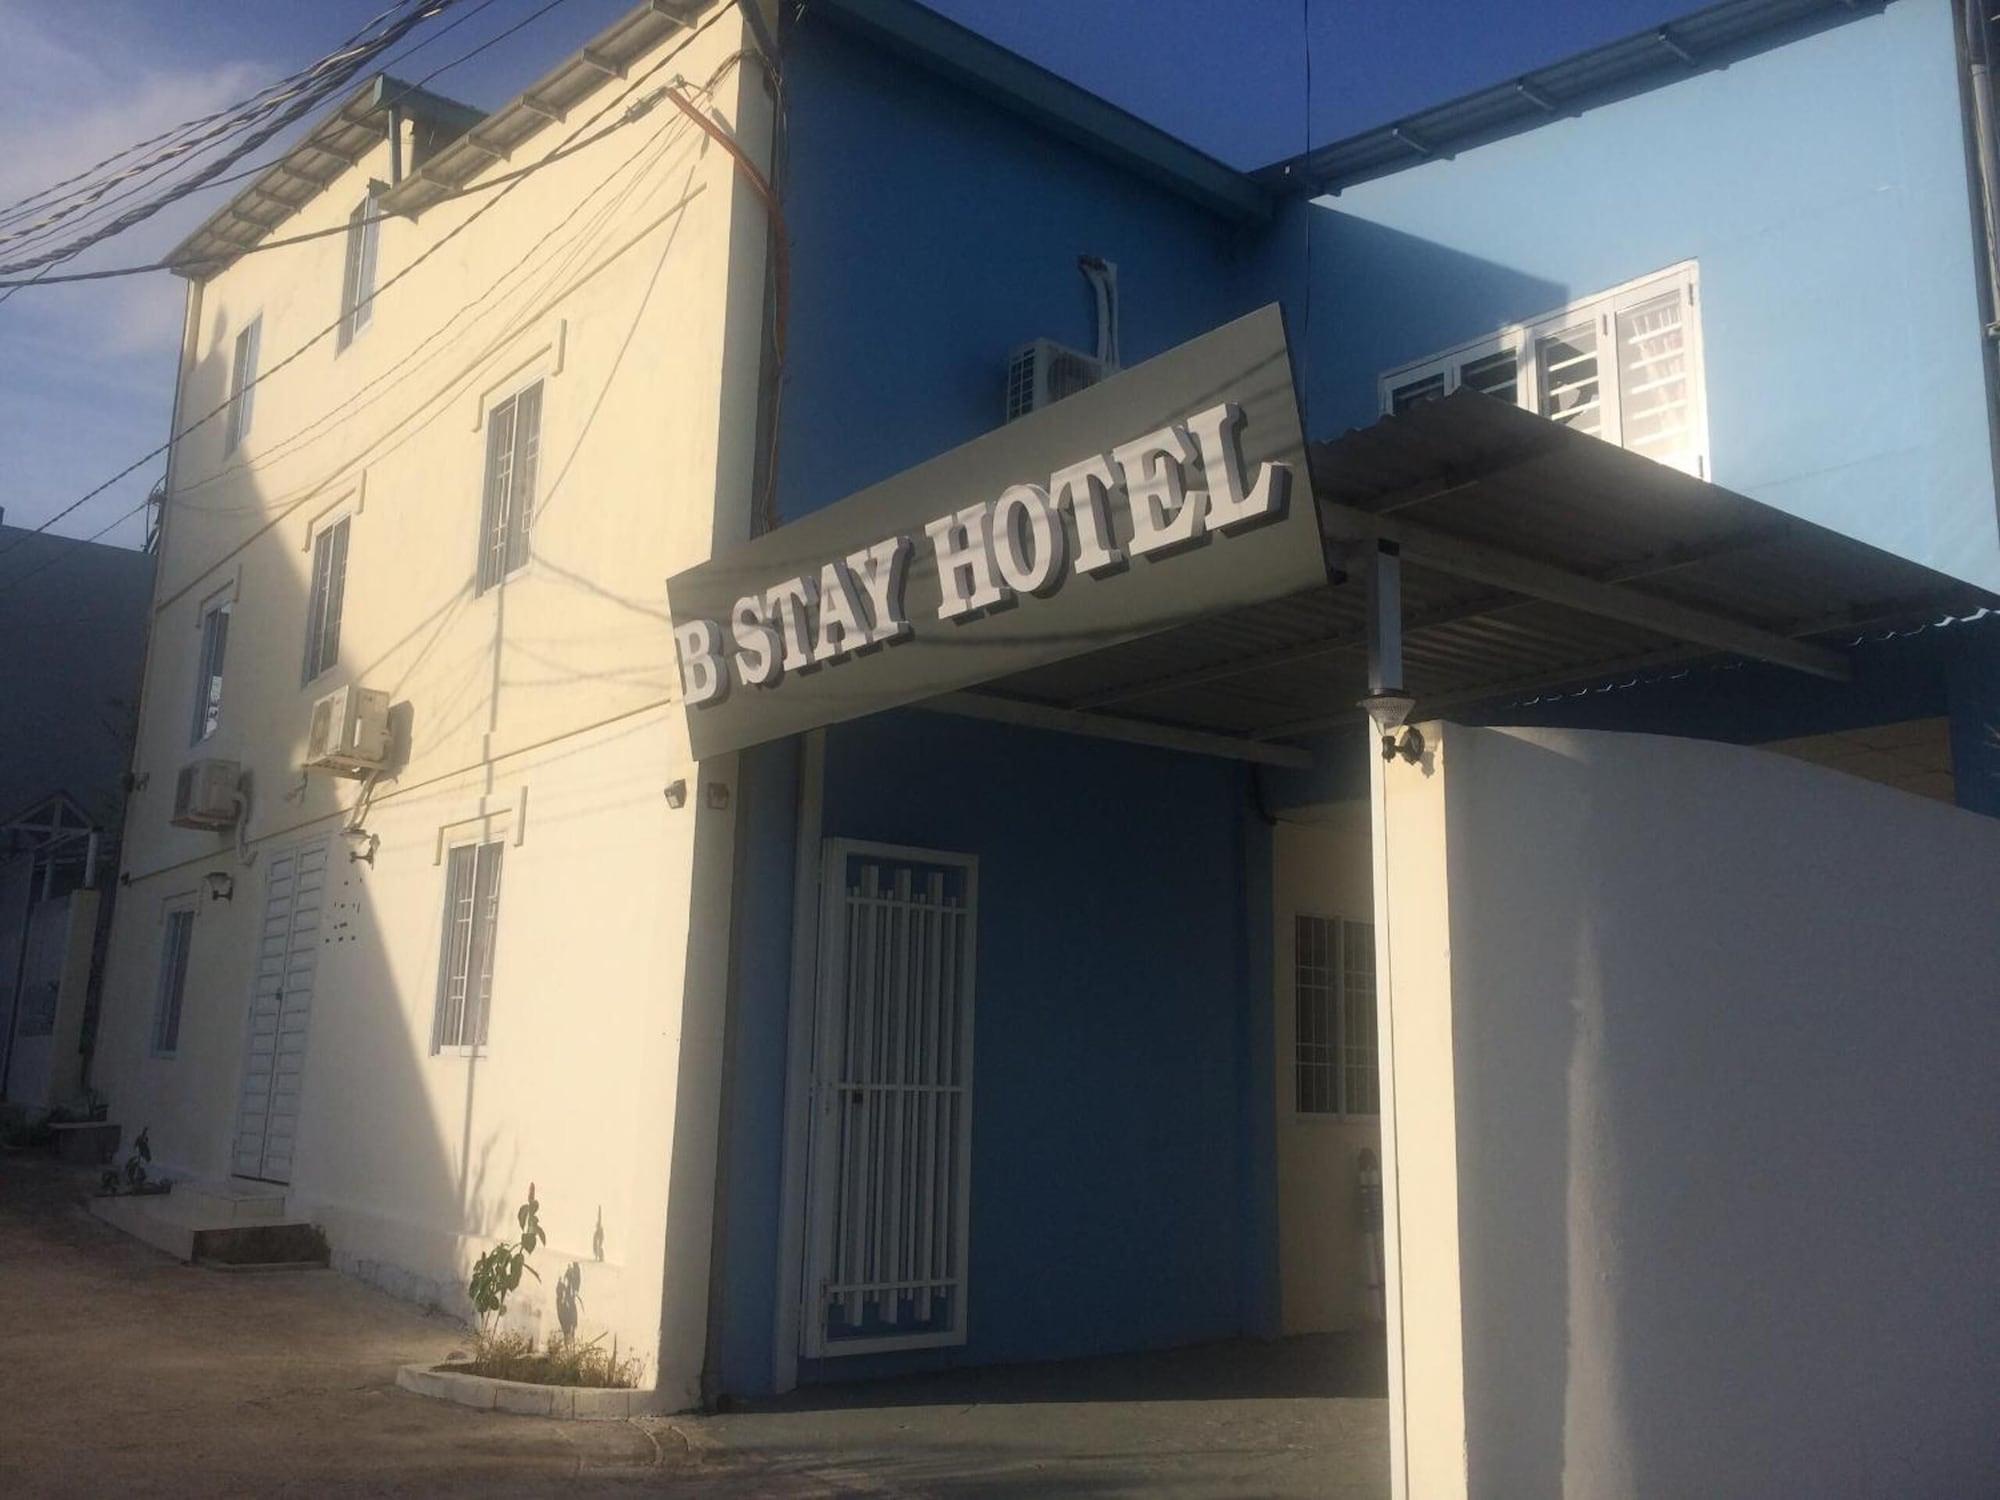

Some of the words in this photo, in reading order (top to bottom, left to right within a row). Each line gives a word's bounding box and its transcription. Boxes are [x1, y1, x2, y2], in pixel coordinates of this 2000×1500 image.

[674, 619, 723, 706] B
[731, 533, 910, 686] STAY
[924, 402, 1287, 621] HOTEL
